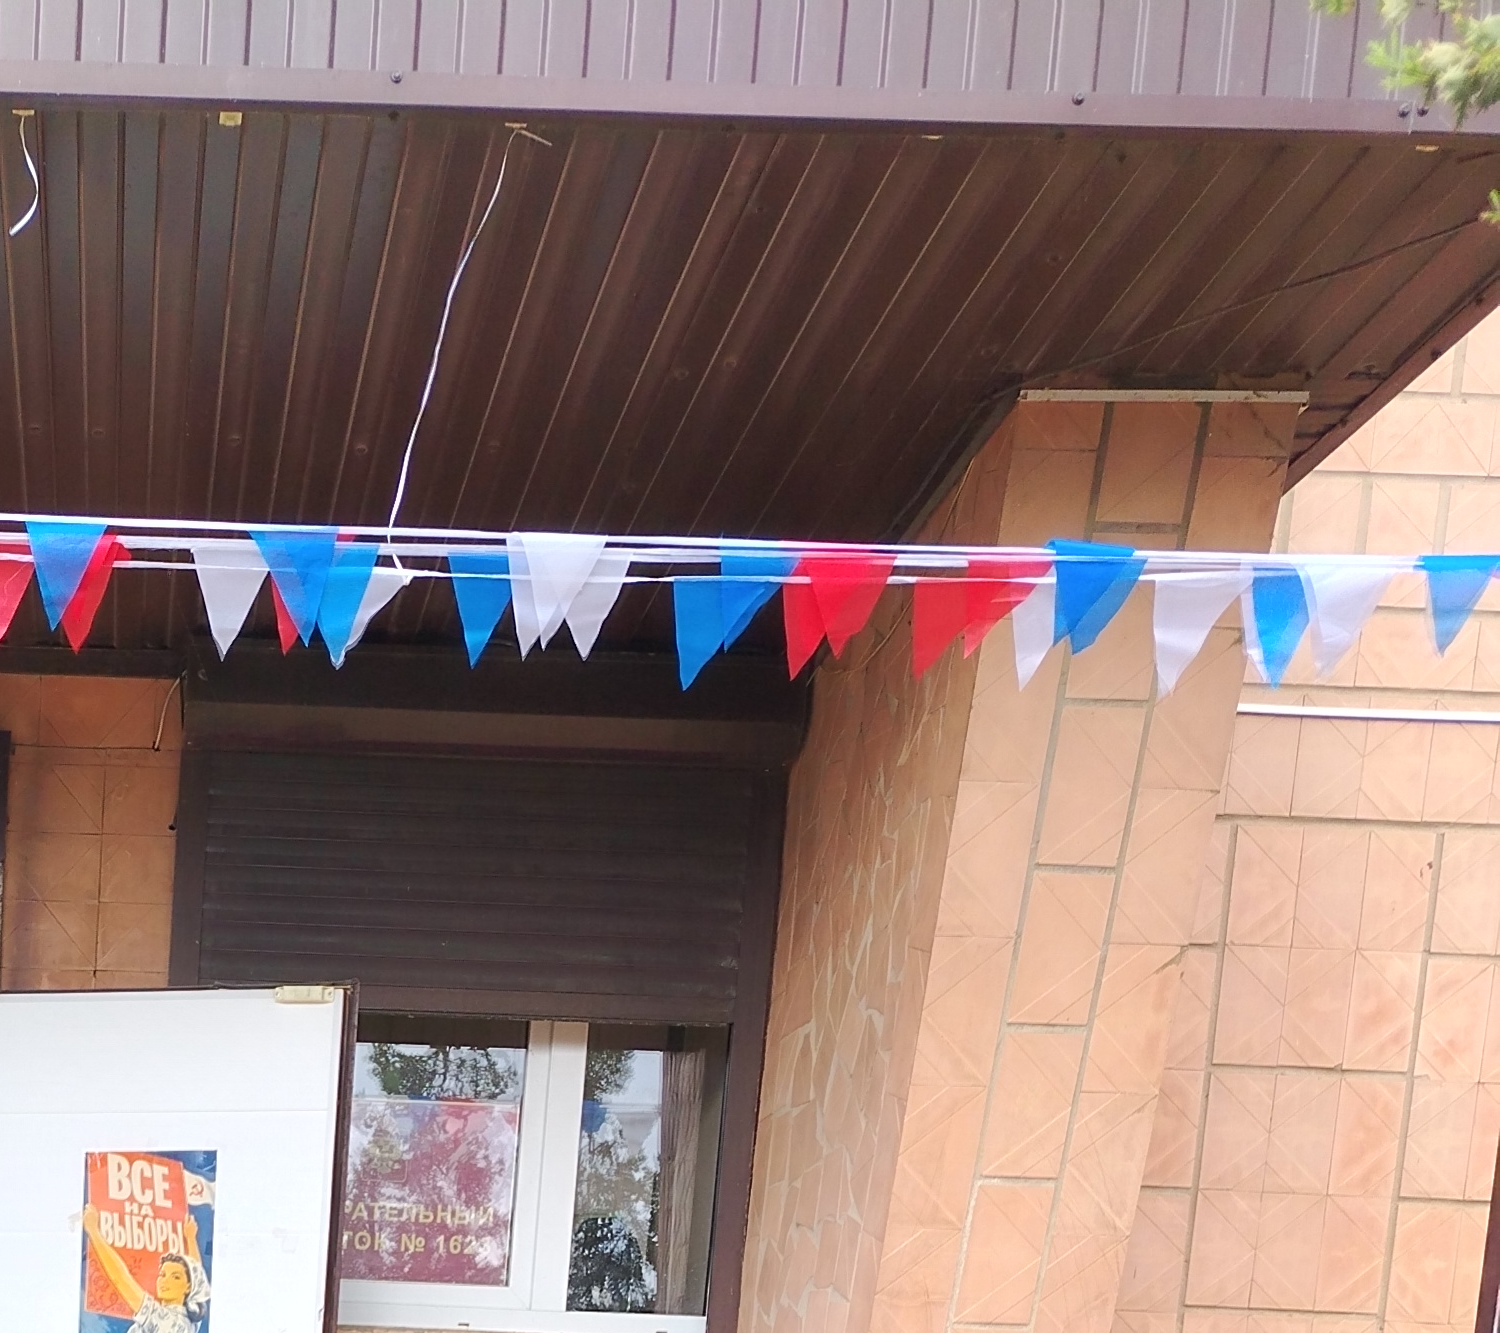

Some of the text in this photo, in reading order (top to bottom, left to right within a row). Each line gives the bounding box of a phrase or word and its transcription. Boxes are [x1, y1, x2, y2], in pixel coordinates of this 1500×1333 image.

[107, 1153, 172, 1208] ВСЕ
[124, 1202, 154, 1217] НА
[100, 1211, 185, 1254] ВЫБОРЫ
[401, 1233, 425, 1252] №
